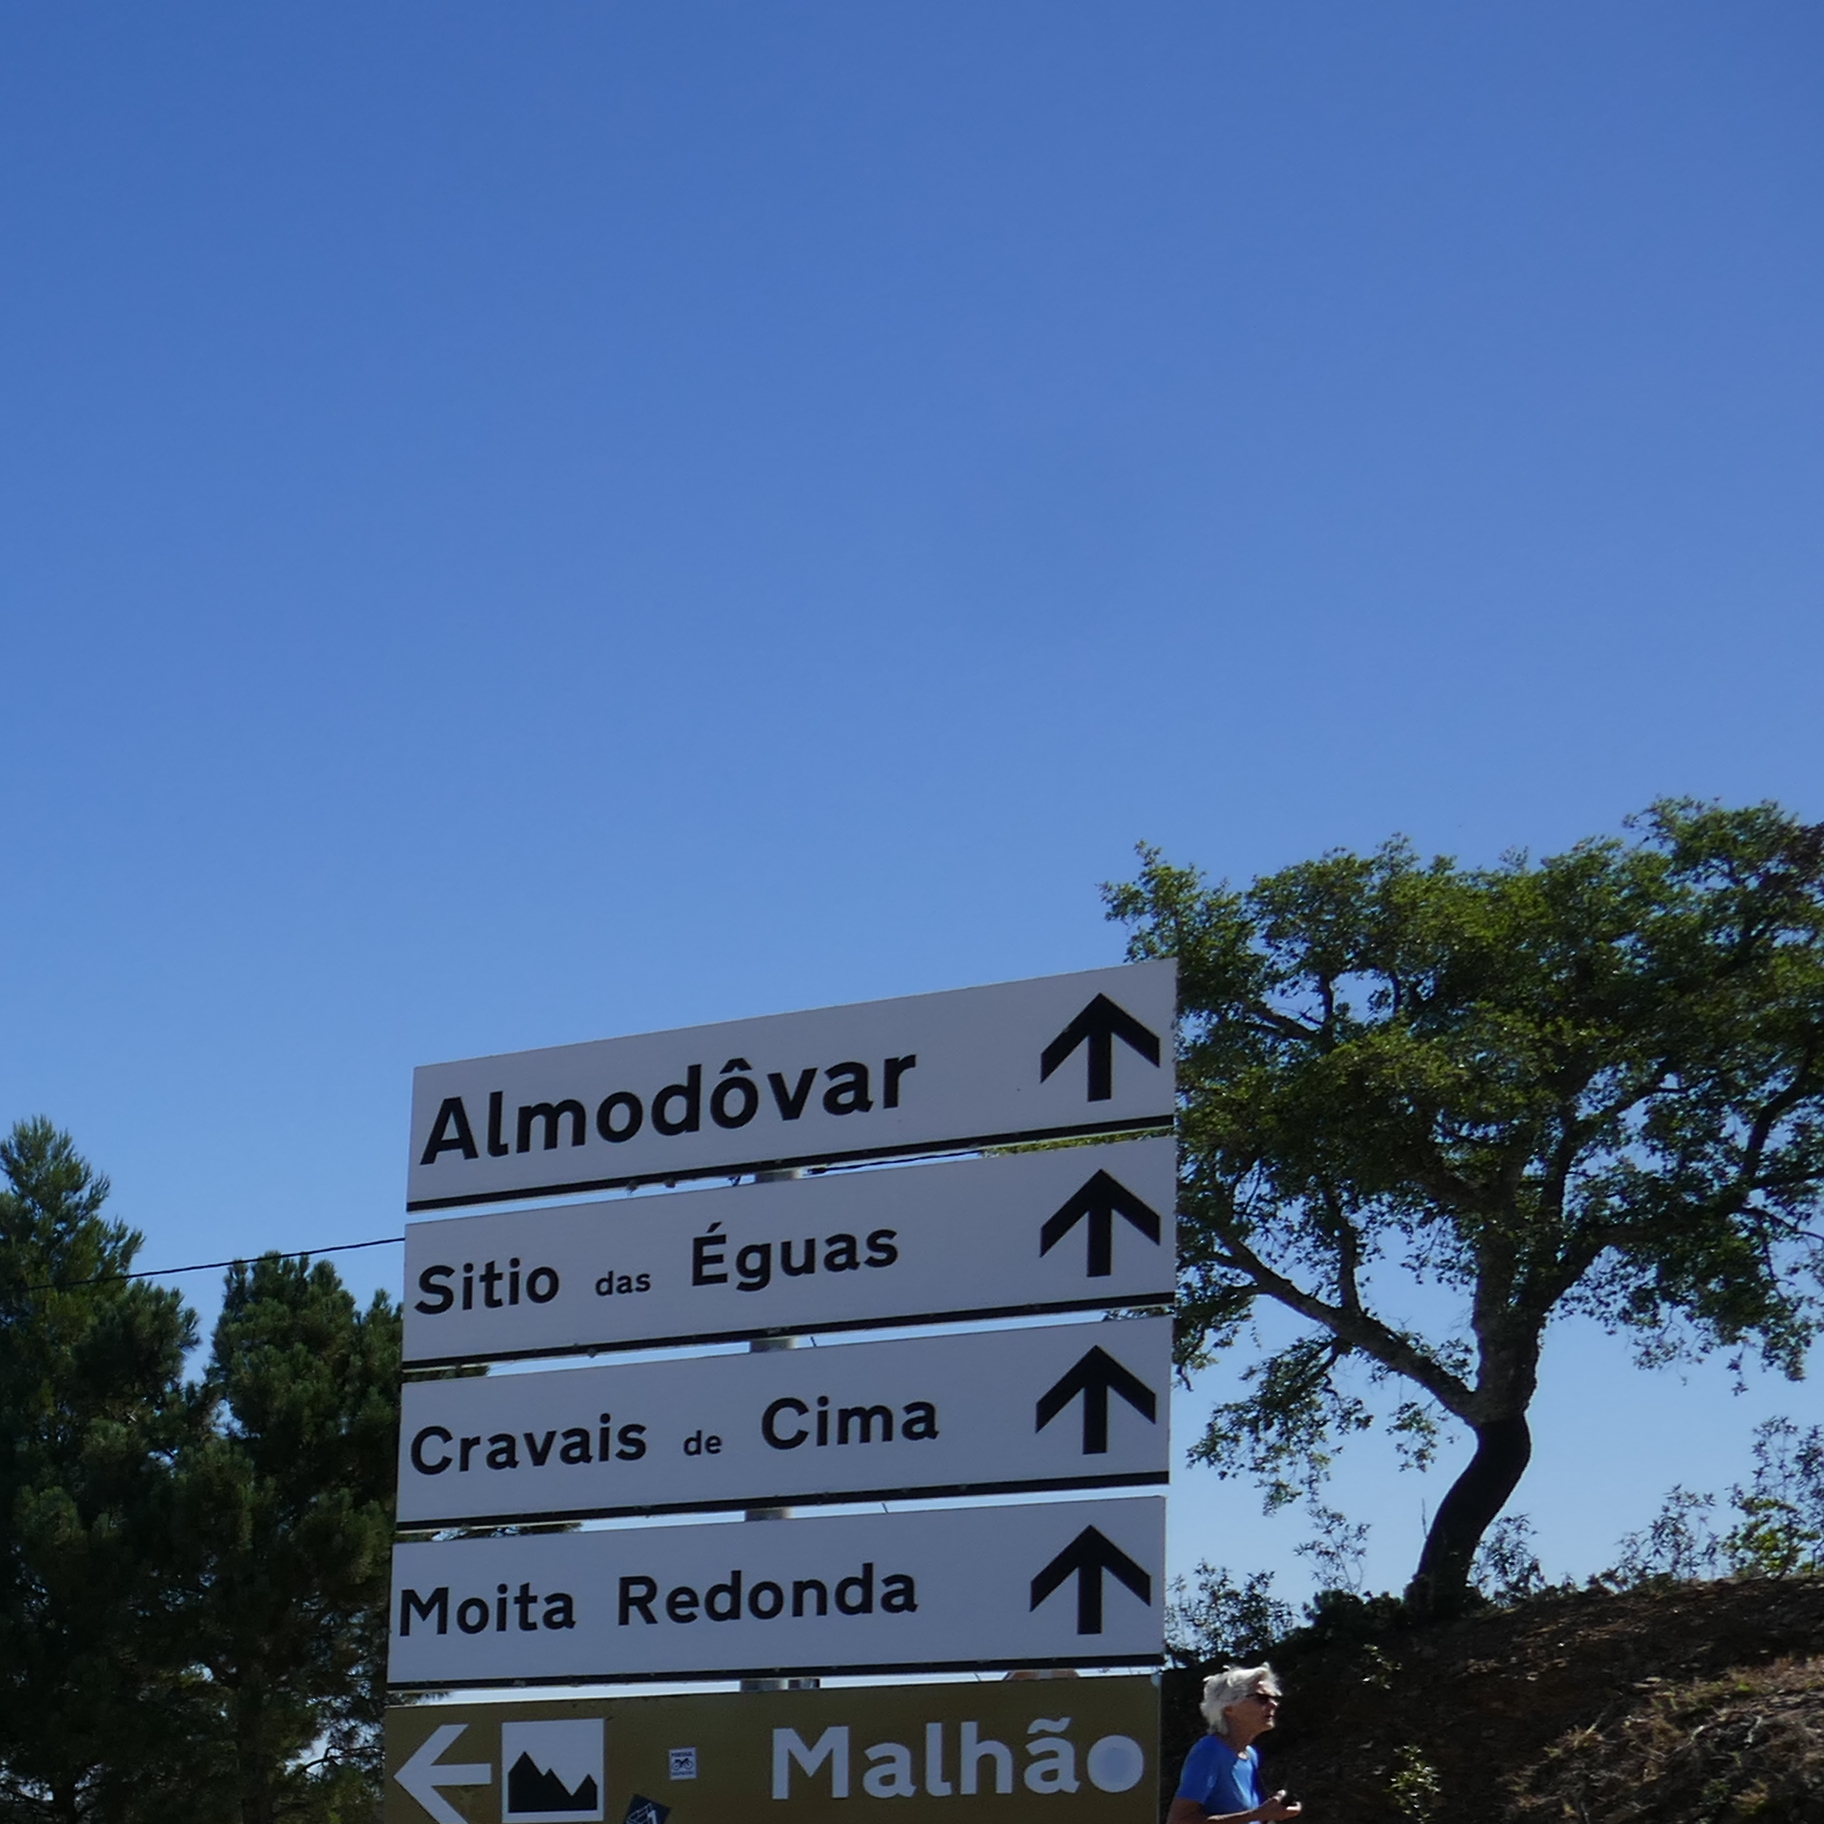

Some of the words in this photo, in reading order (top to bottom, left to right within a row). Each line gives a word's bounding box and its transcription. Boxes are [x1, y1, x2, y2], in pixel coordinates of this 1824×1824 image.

[419, 1053, 918, 1166] Almodôvar
[414, 1257, 560, 1315] Sitio
[595, 1270, 651, 1297] das
[691, 1221, 899, 1292] Éguas
[410, 1412, 647, 1476] Cravais
[683, 1429, 723, 1457] de
[761, 1395, 940, 1451] Cima
[399, 1582, 577, 1637] Moita
[618, 1562, 919, 1626] Redonda
[771, 1717, 1144, 1800] Malhão
